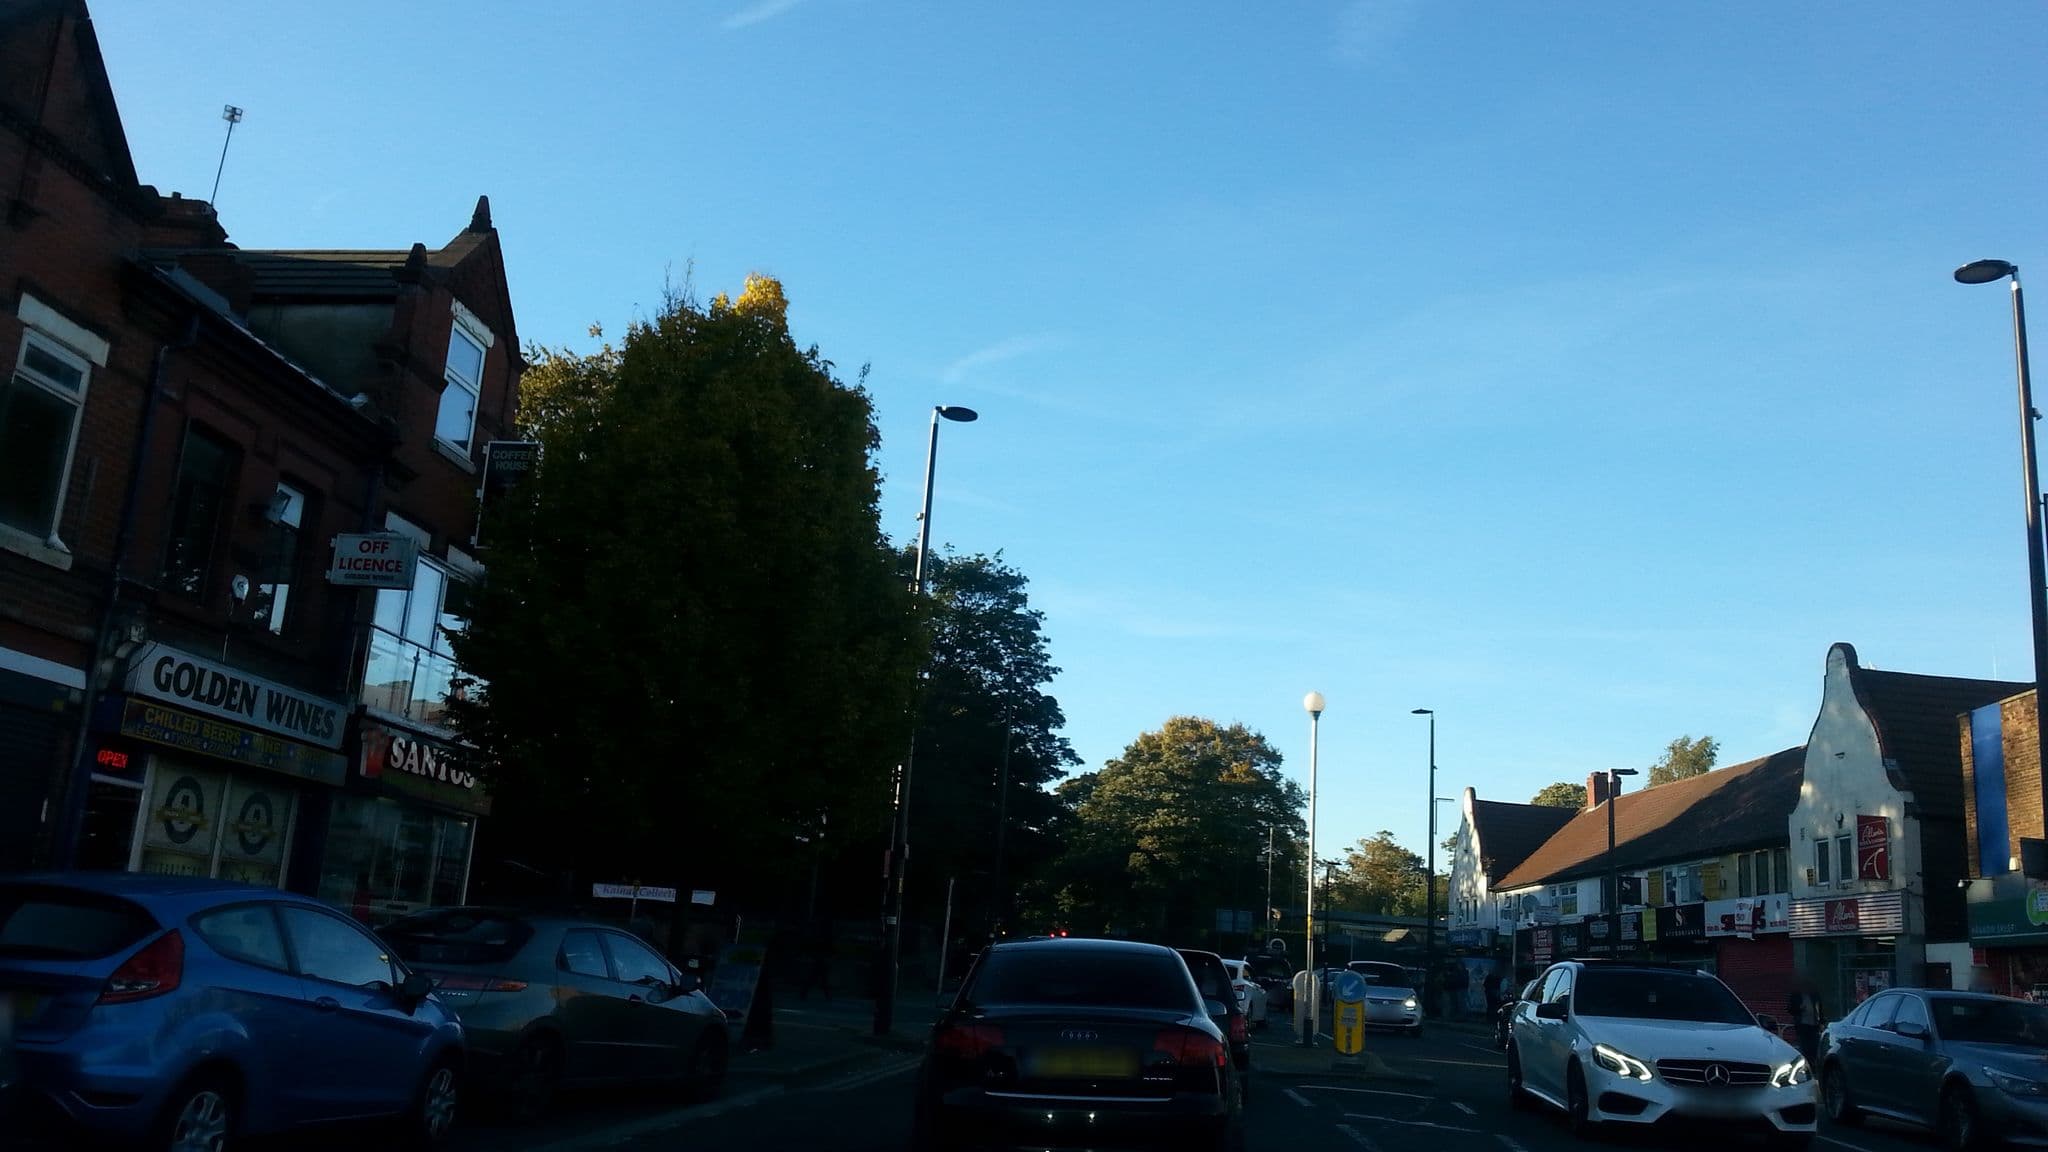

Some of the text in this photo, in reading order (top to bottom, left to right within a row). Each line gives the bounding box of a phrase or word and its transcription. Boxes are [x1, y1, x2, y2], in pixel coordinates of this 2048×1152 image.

[495, 459, 529, 472] HOUSE
[358, 540, 390, 554] OFF
[338, 557, 403, 573] LICENCE
[153, 656, 336, 740] GOLDEN WINES
[144, 706, 198, 736] CHILLED
[202, 722, 242, 747] BEERS
[96, 749, 129, 770] OPEN
